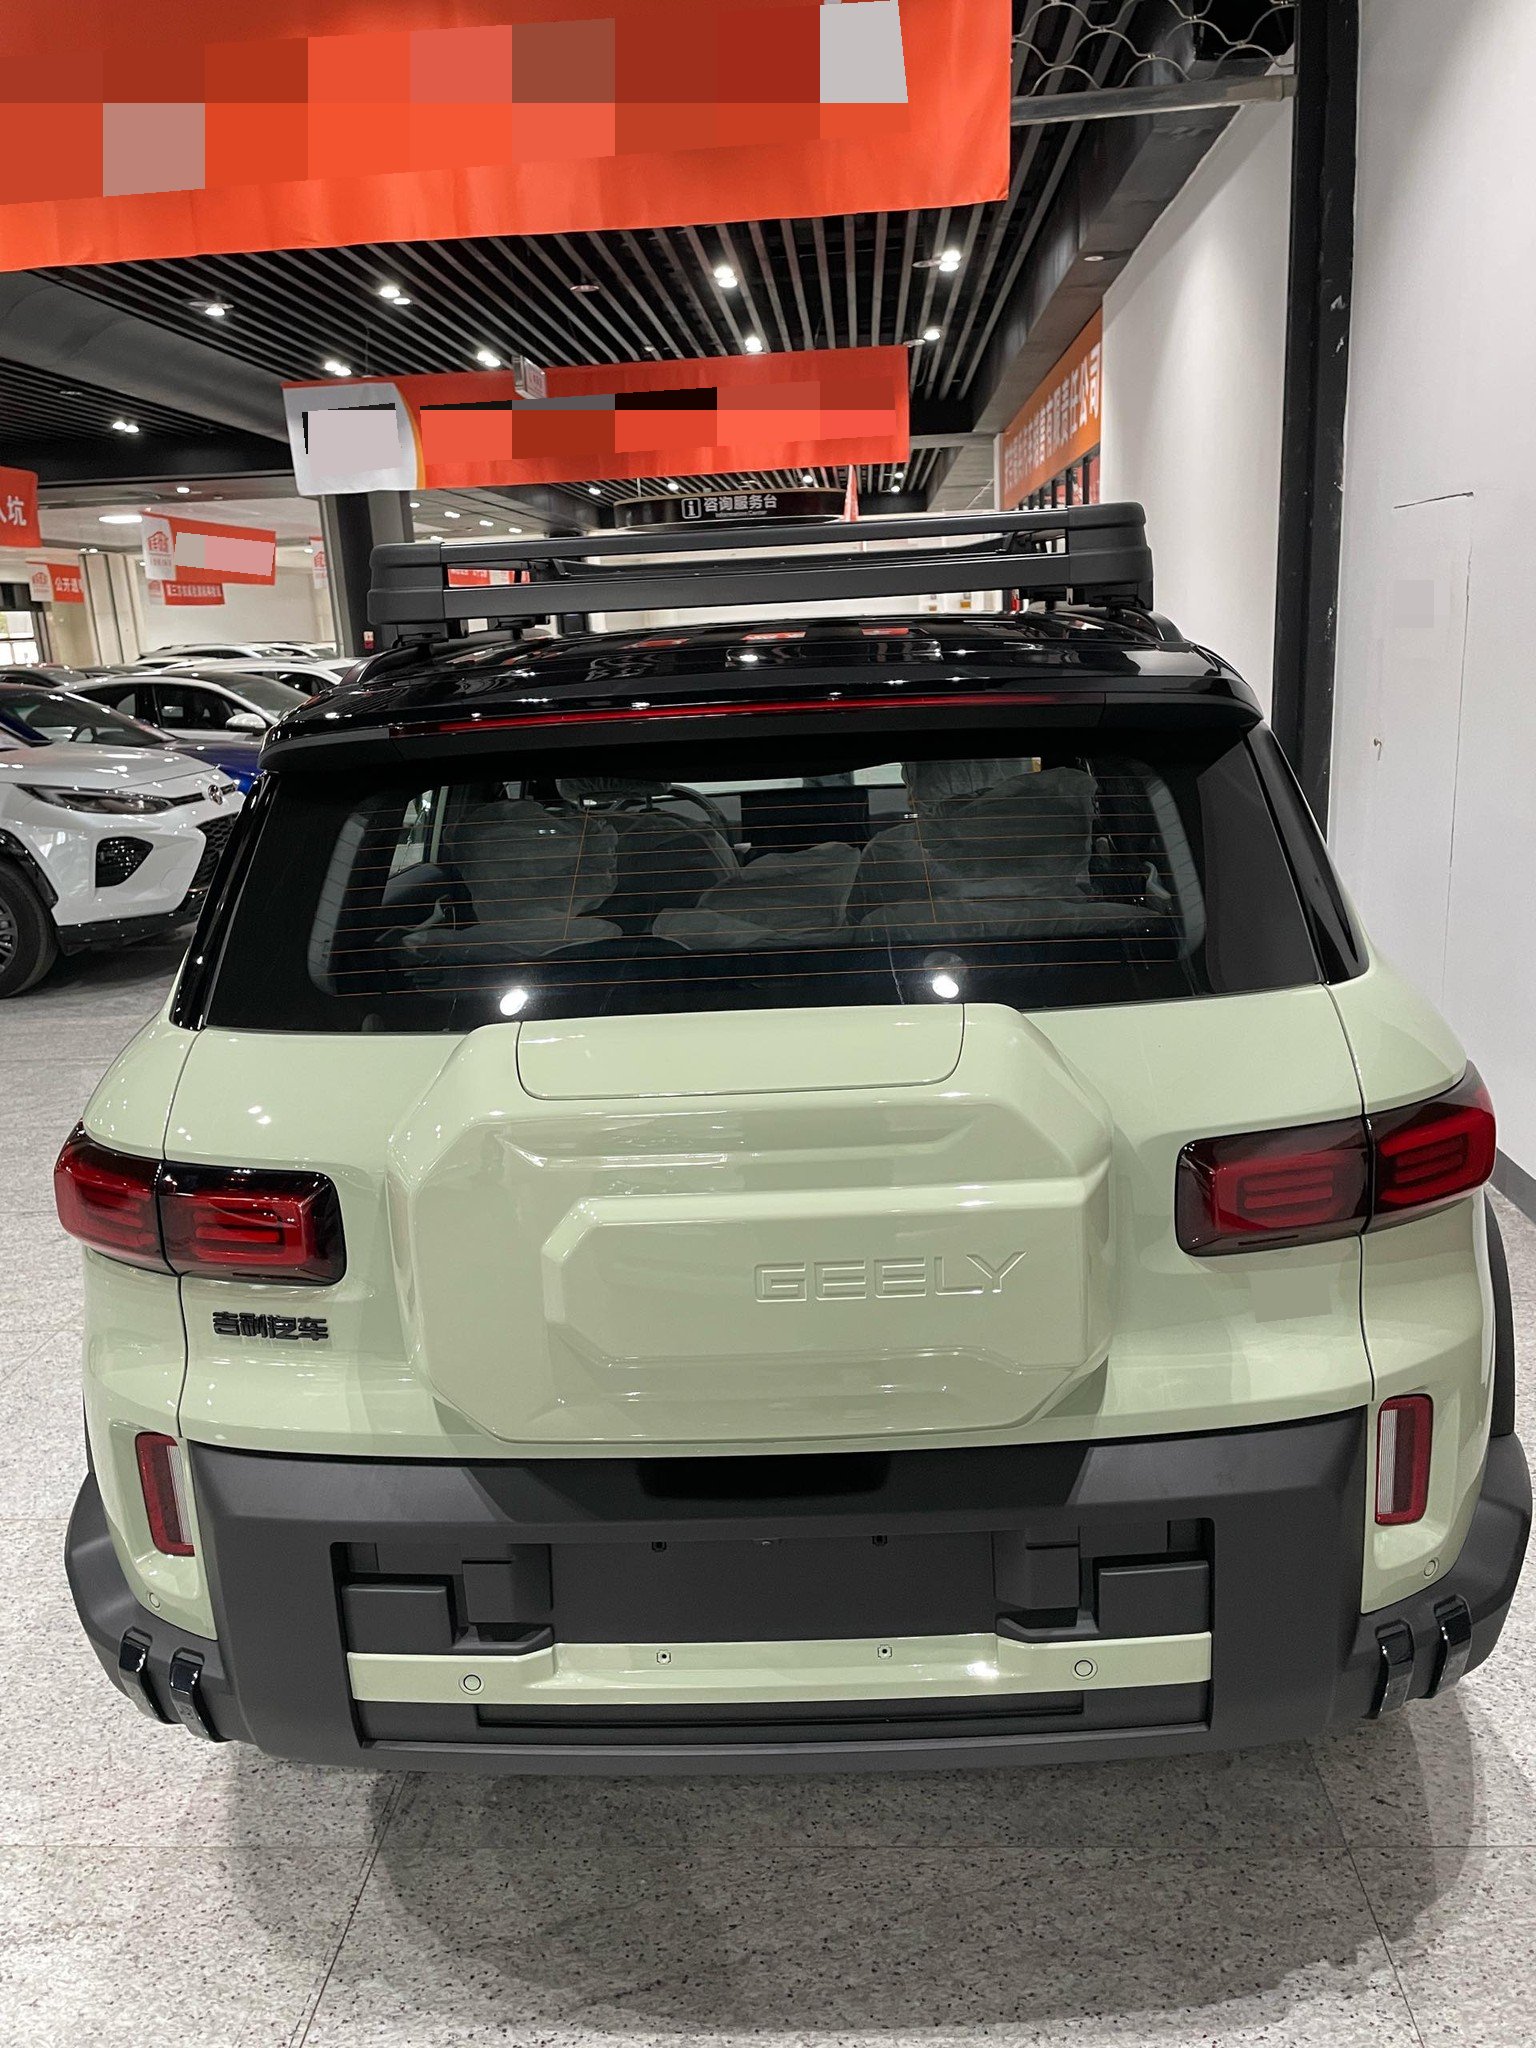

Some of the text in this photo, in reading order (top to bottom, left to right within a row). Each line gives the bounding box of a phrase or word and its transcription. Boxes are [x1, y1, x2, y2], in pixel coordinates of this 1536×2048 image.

[703, 494, 778, 513] 咨询服务台
[754, 1251, 1027, 1303] GEELY
[212, 1311, 328, 1341] 吉利汽车
